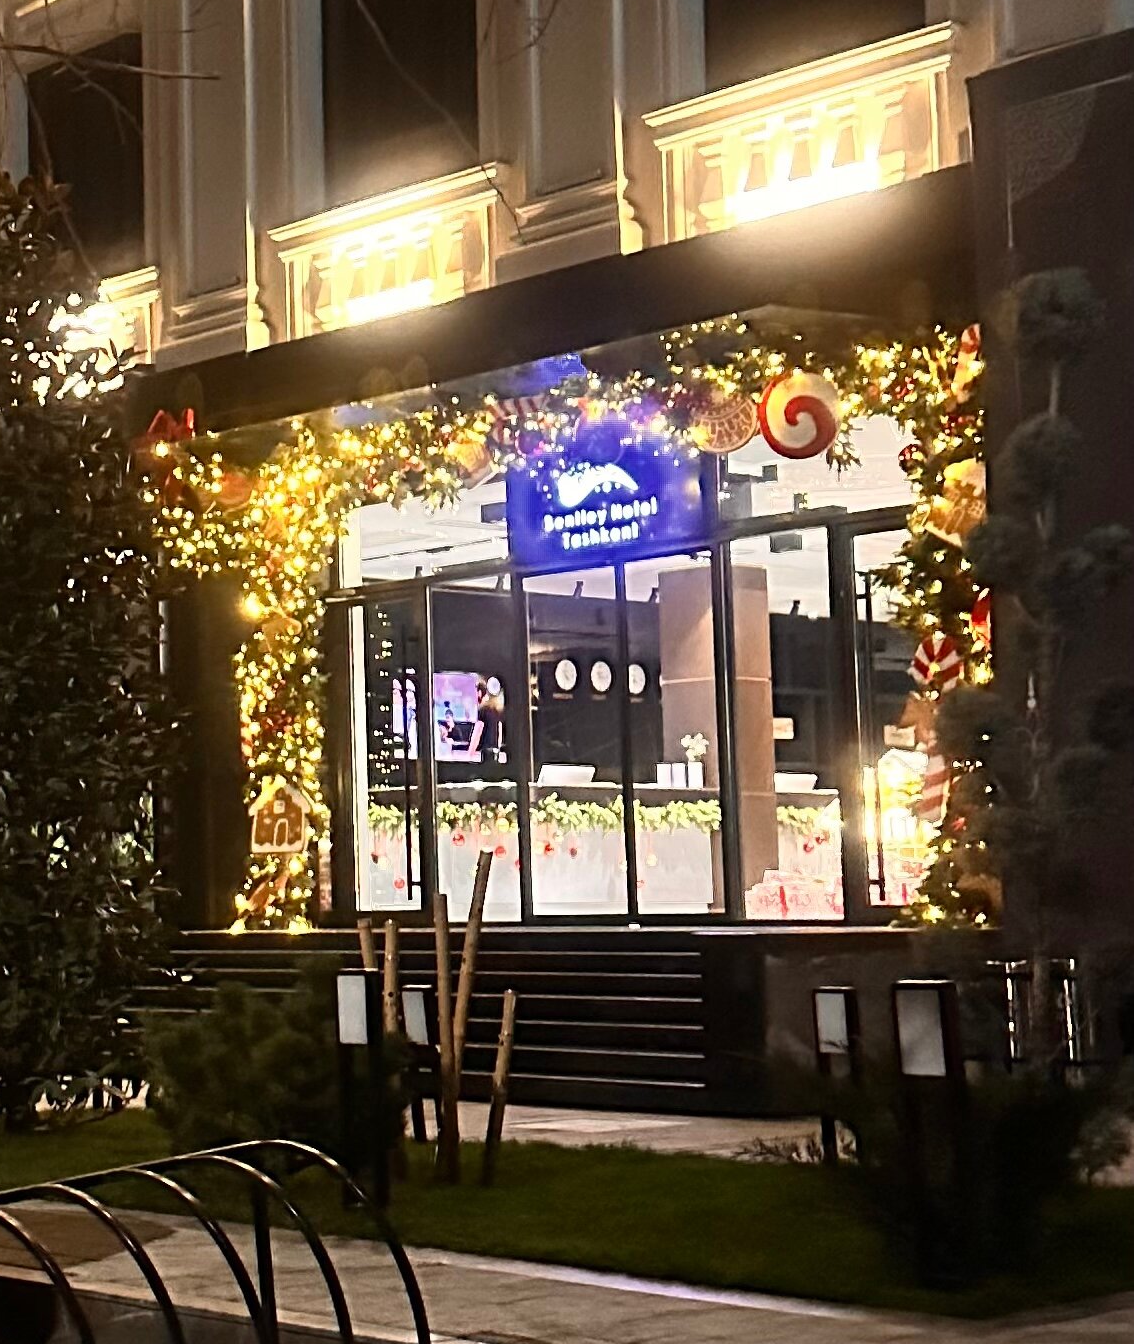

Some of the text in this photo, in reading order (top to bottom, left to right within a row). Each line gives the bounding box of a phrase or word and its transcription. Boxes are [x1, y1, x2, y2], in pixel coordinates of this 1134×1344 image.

[543, 496, 657, 533] Bentley Hotel
[562, 521, 639, 550] Tashkent
